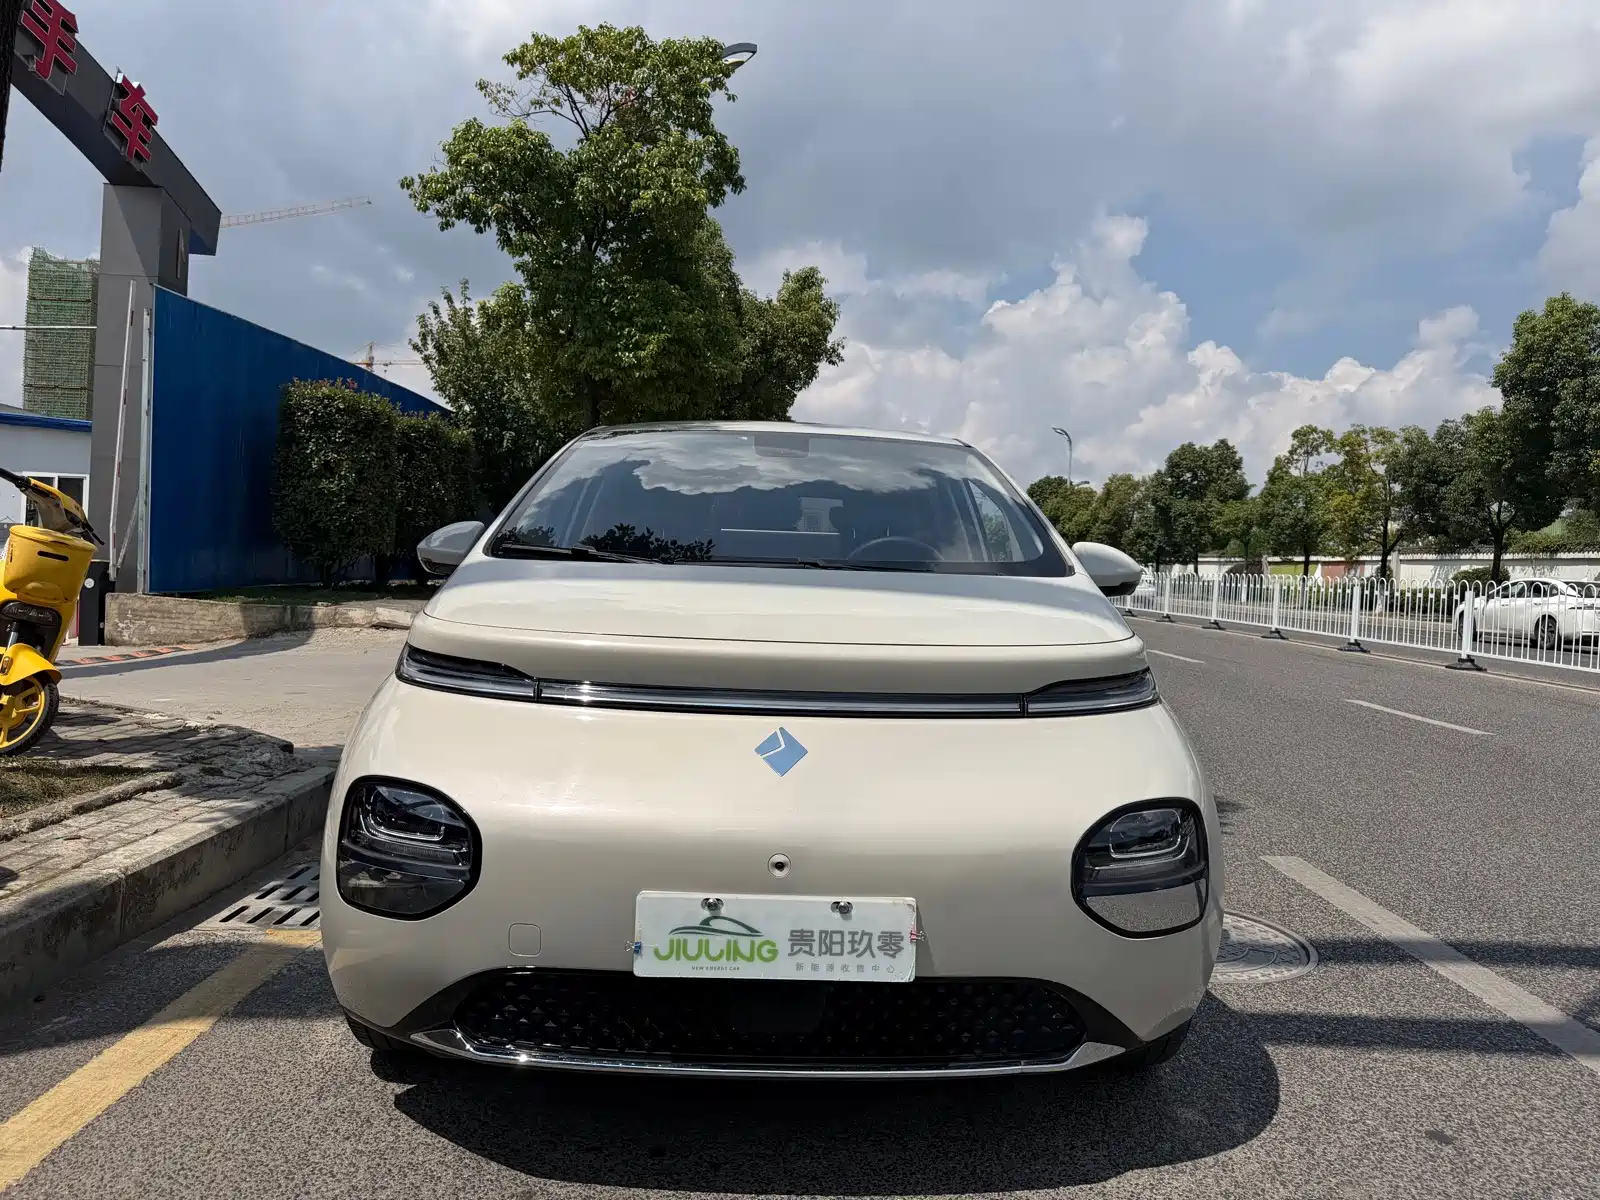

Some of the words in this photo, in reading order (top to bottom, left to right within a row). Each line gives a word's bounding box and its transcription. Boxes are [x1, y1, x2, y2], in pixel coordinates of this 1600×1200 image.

[653, 938, 779, 963] JIULING
[787, 929, 905, 959] 贵阳玖零
